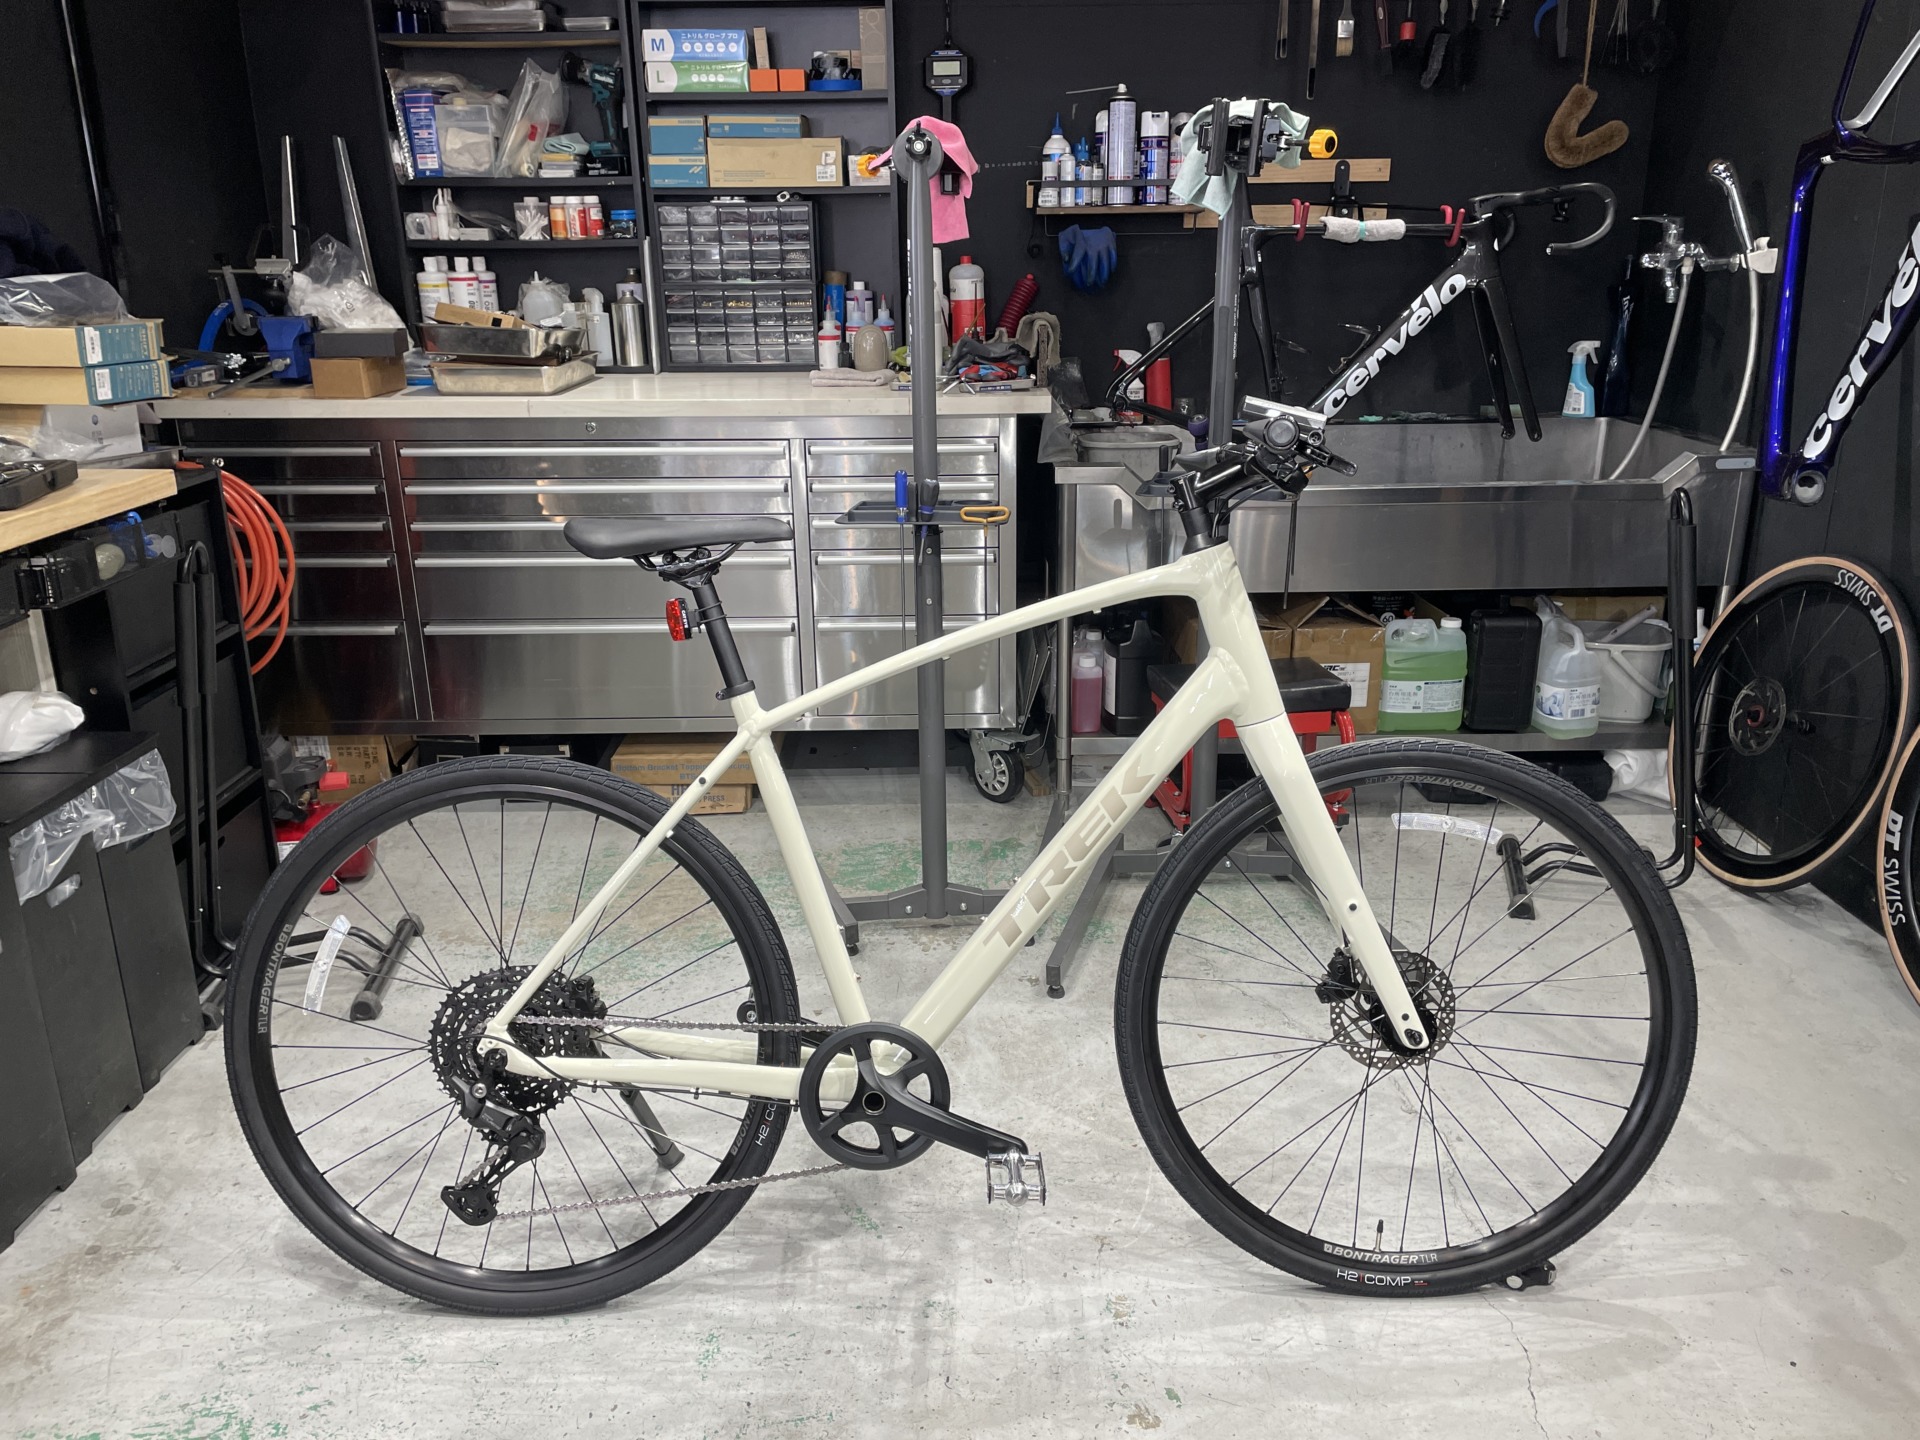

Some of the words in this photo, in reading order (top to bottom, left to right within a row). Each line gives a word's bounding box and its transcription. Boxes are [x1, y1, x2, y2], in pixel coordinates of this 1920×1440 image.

[651, 38, 665, 51] M
[656, 70, 665, 83] L
[1323, 273, 1468, 419] cervélo
[151, 363, 160, 395] BRAKE
[1834, 568, 1877, 607] SWISS
[1868, 604, 1894, 635] DT
[1385, 775, 1476, 791] BONTRAGER
[1884, 810, 1904, 852] DT
[982, 754, 1156, 947] TREK
[1882, 857, 1906, 926] SWISS
[260, 932, 291, 1015] BONTRAGER
[1333, 1246, 1419, 1265] BONTRAGER
[1419, 1253, 1438, 1263] TLR
[1364, 1273, 1412, 1287] COMP
